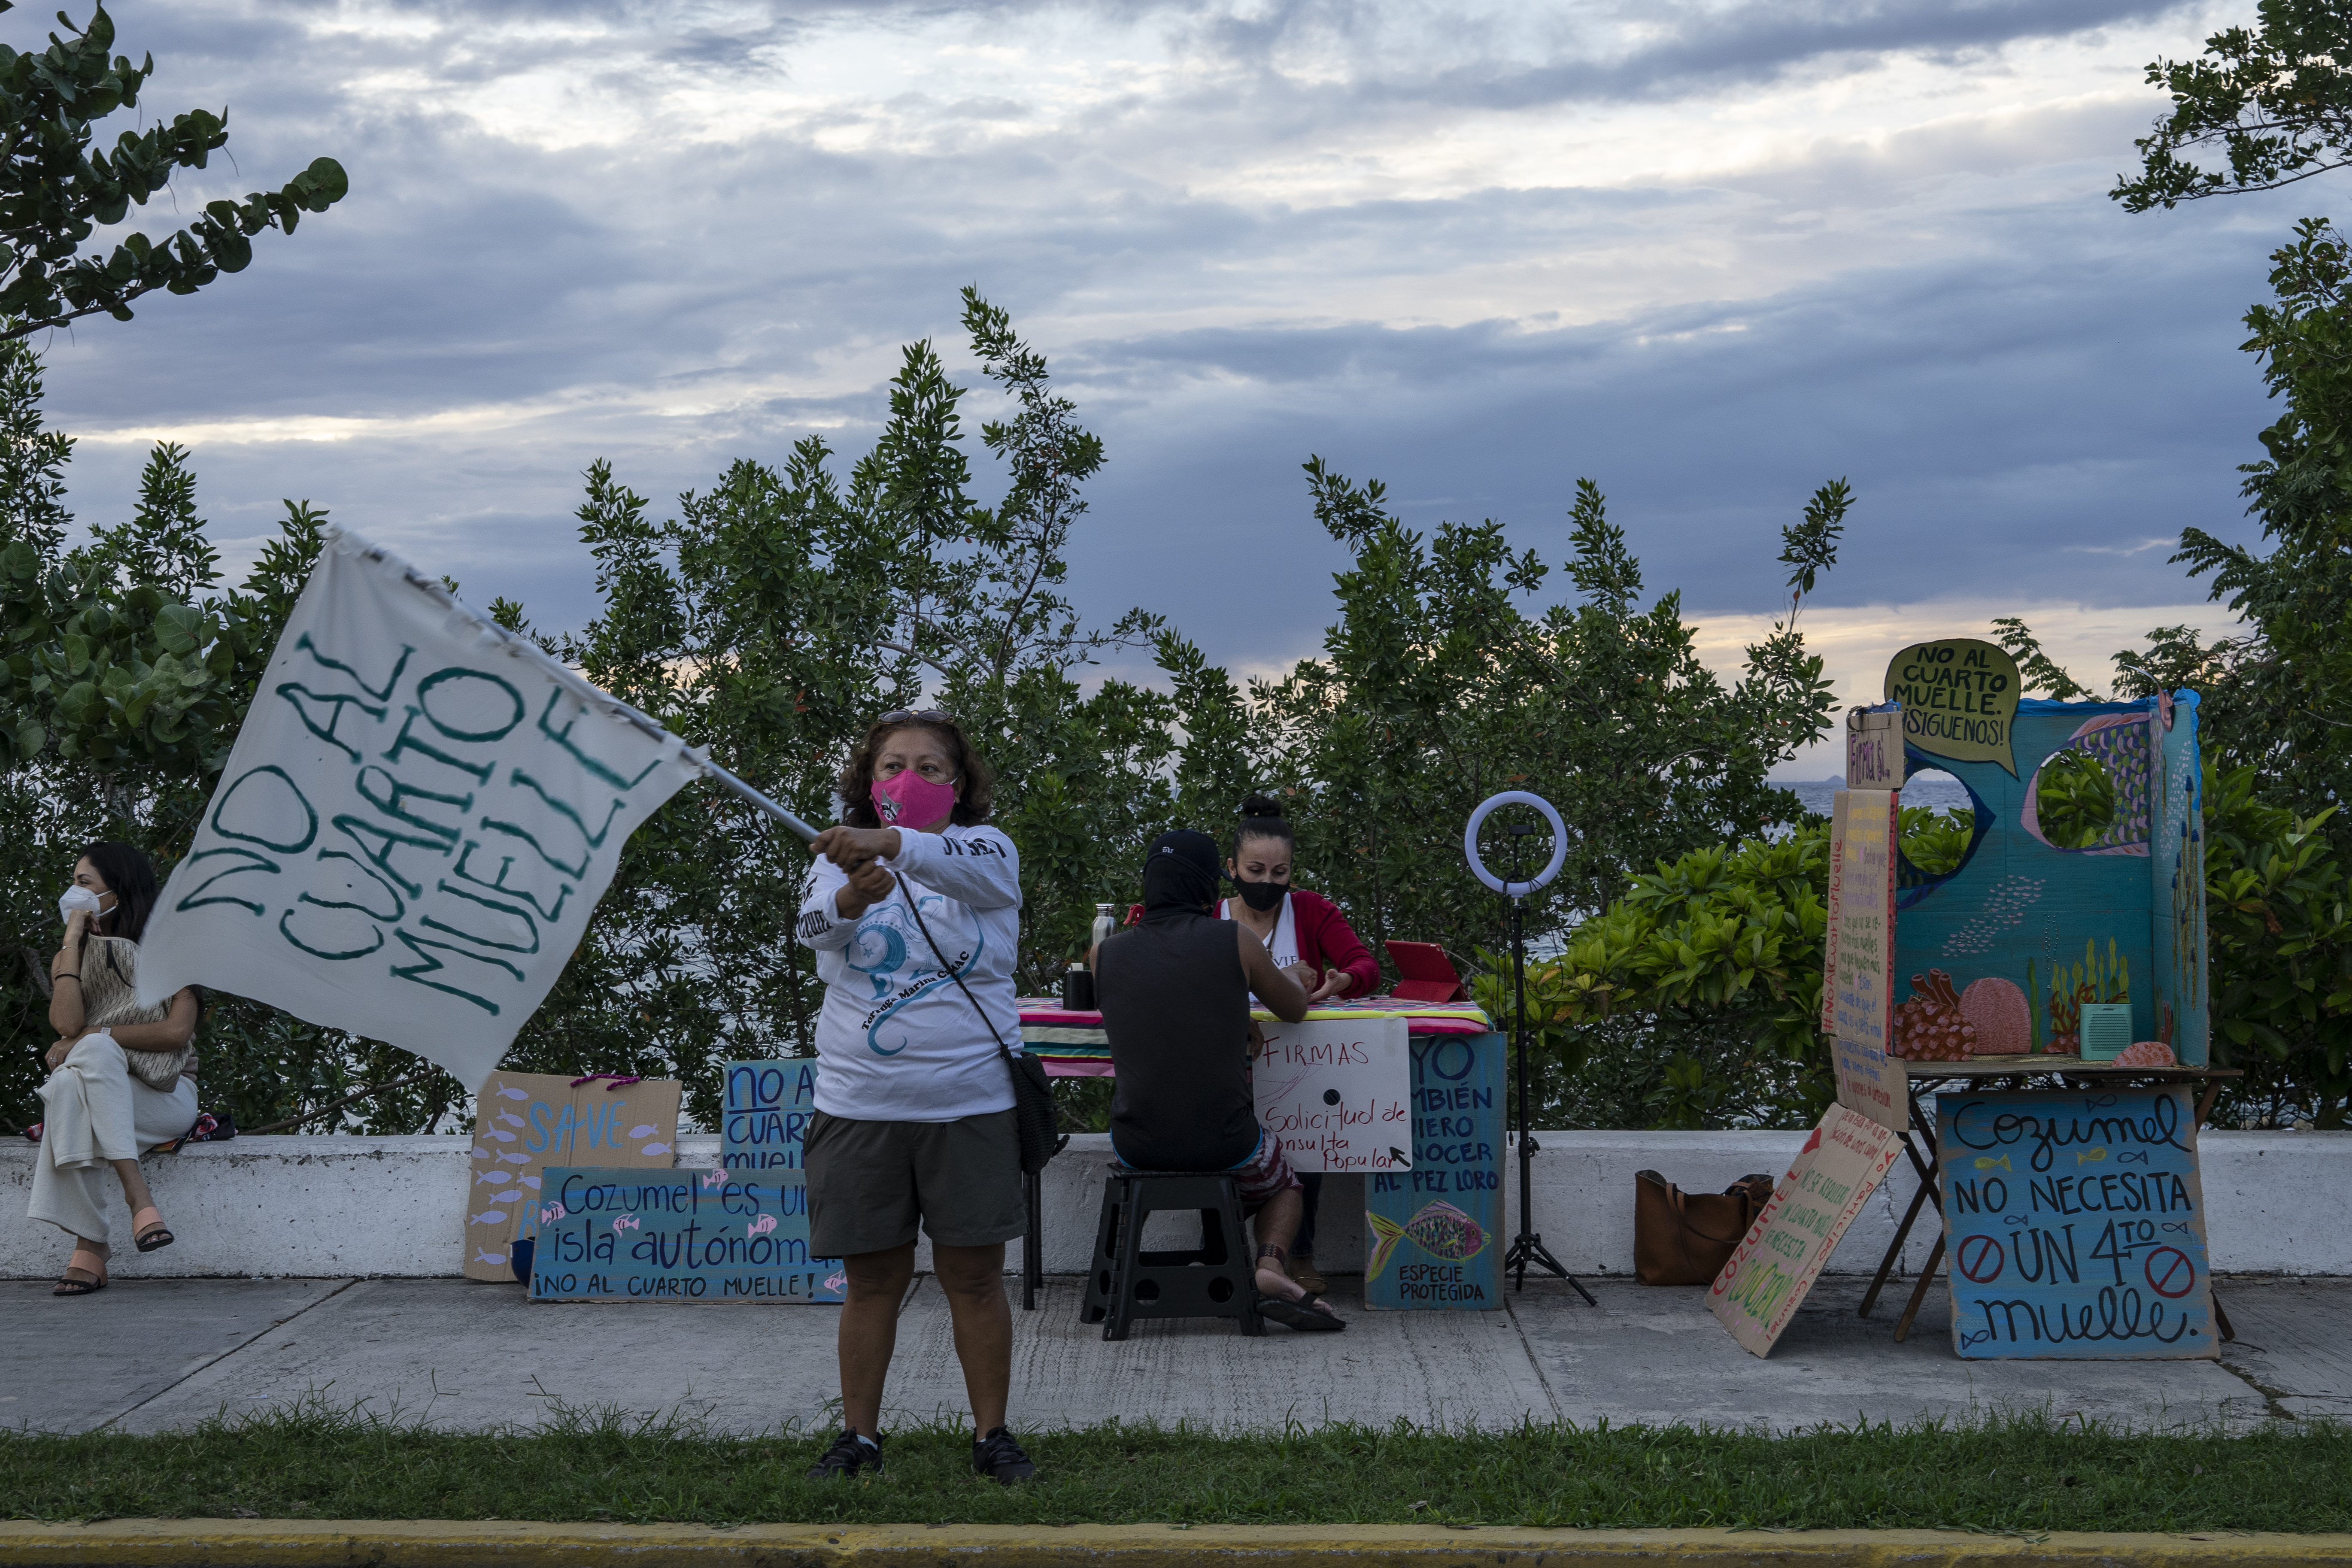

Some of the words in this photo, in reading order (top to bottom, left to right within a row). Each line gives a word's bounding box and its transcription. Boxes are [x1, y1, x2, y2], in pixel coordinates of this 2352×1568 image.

[1917, 647, 1954, 663] NO
[1964, 649, 1990, 668] AL
[1903, 665, 2008, 692] CUARTO
[1893, 684, 2001, 715] MUELLE.
[176, 765, 319, 916] NO
[276, 632, 415, 763] AL
[280, 666, 525, 960] CUARTO
[390, 686, 664, 1016] MUELLE
[862, 998, 898, 1031] Tortuga
[898, 977, 938, 999] Marina
[1262, 1036, 1369, 1068] FIRMAS
[1409, 1035, 1475, 1085] YO
[795, 1065, 815, 1105] A
[1411, 1081, 1492, 1113] MBIÉN
[525, 1101, 627, 1153] SAVE
[1266, 1099, 1375, 1132] Solicitud
[1382, 1101, 1407, 1122] de
[1954, 1094, 2192, 1172] Cozumel
[1323, 1148, 1393, 1172] Popular
[561, 1173, 698, 1214] Cozumel
[722, 1183, 759, 1216] es
[1375, 1172, 1401, 1193] AL
[1412, 1170, 1449, 1193] PEZ
[1455, 1169, 1499, 1192] LORO
[1955, 1177, 2007, 1213] NO
[2030, 1171, 2192, 1215] NECESITA
[1713, 1170, 1802, 1295] COZUMEL
[1788, 1204, 1818, 1228] CUARTO
[555, 1218, 614, 1265] isla
[631, 1218, 835, 1270] autónom.
[1770, 1230, 1807, 1262] NECESITA
[2009, 1223, 2080, 1285] UN
[534, 1273, 577, 1296] ¡NO
[587, 1274, 614, 1294] AL
[628, 1276, 706, 1297] CUARTO
[1399, 1264, 1463, 1283] ESPECIE
[1400, 1282, 1485, 1301] PROTEGIDA
